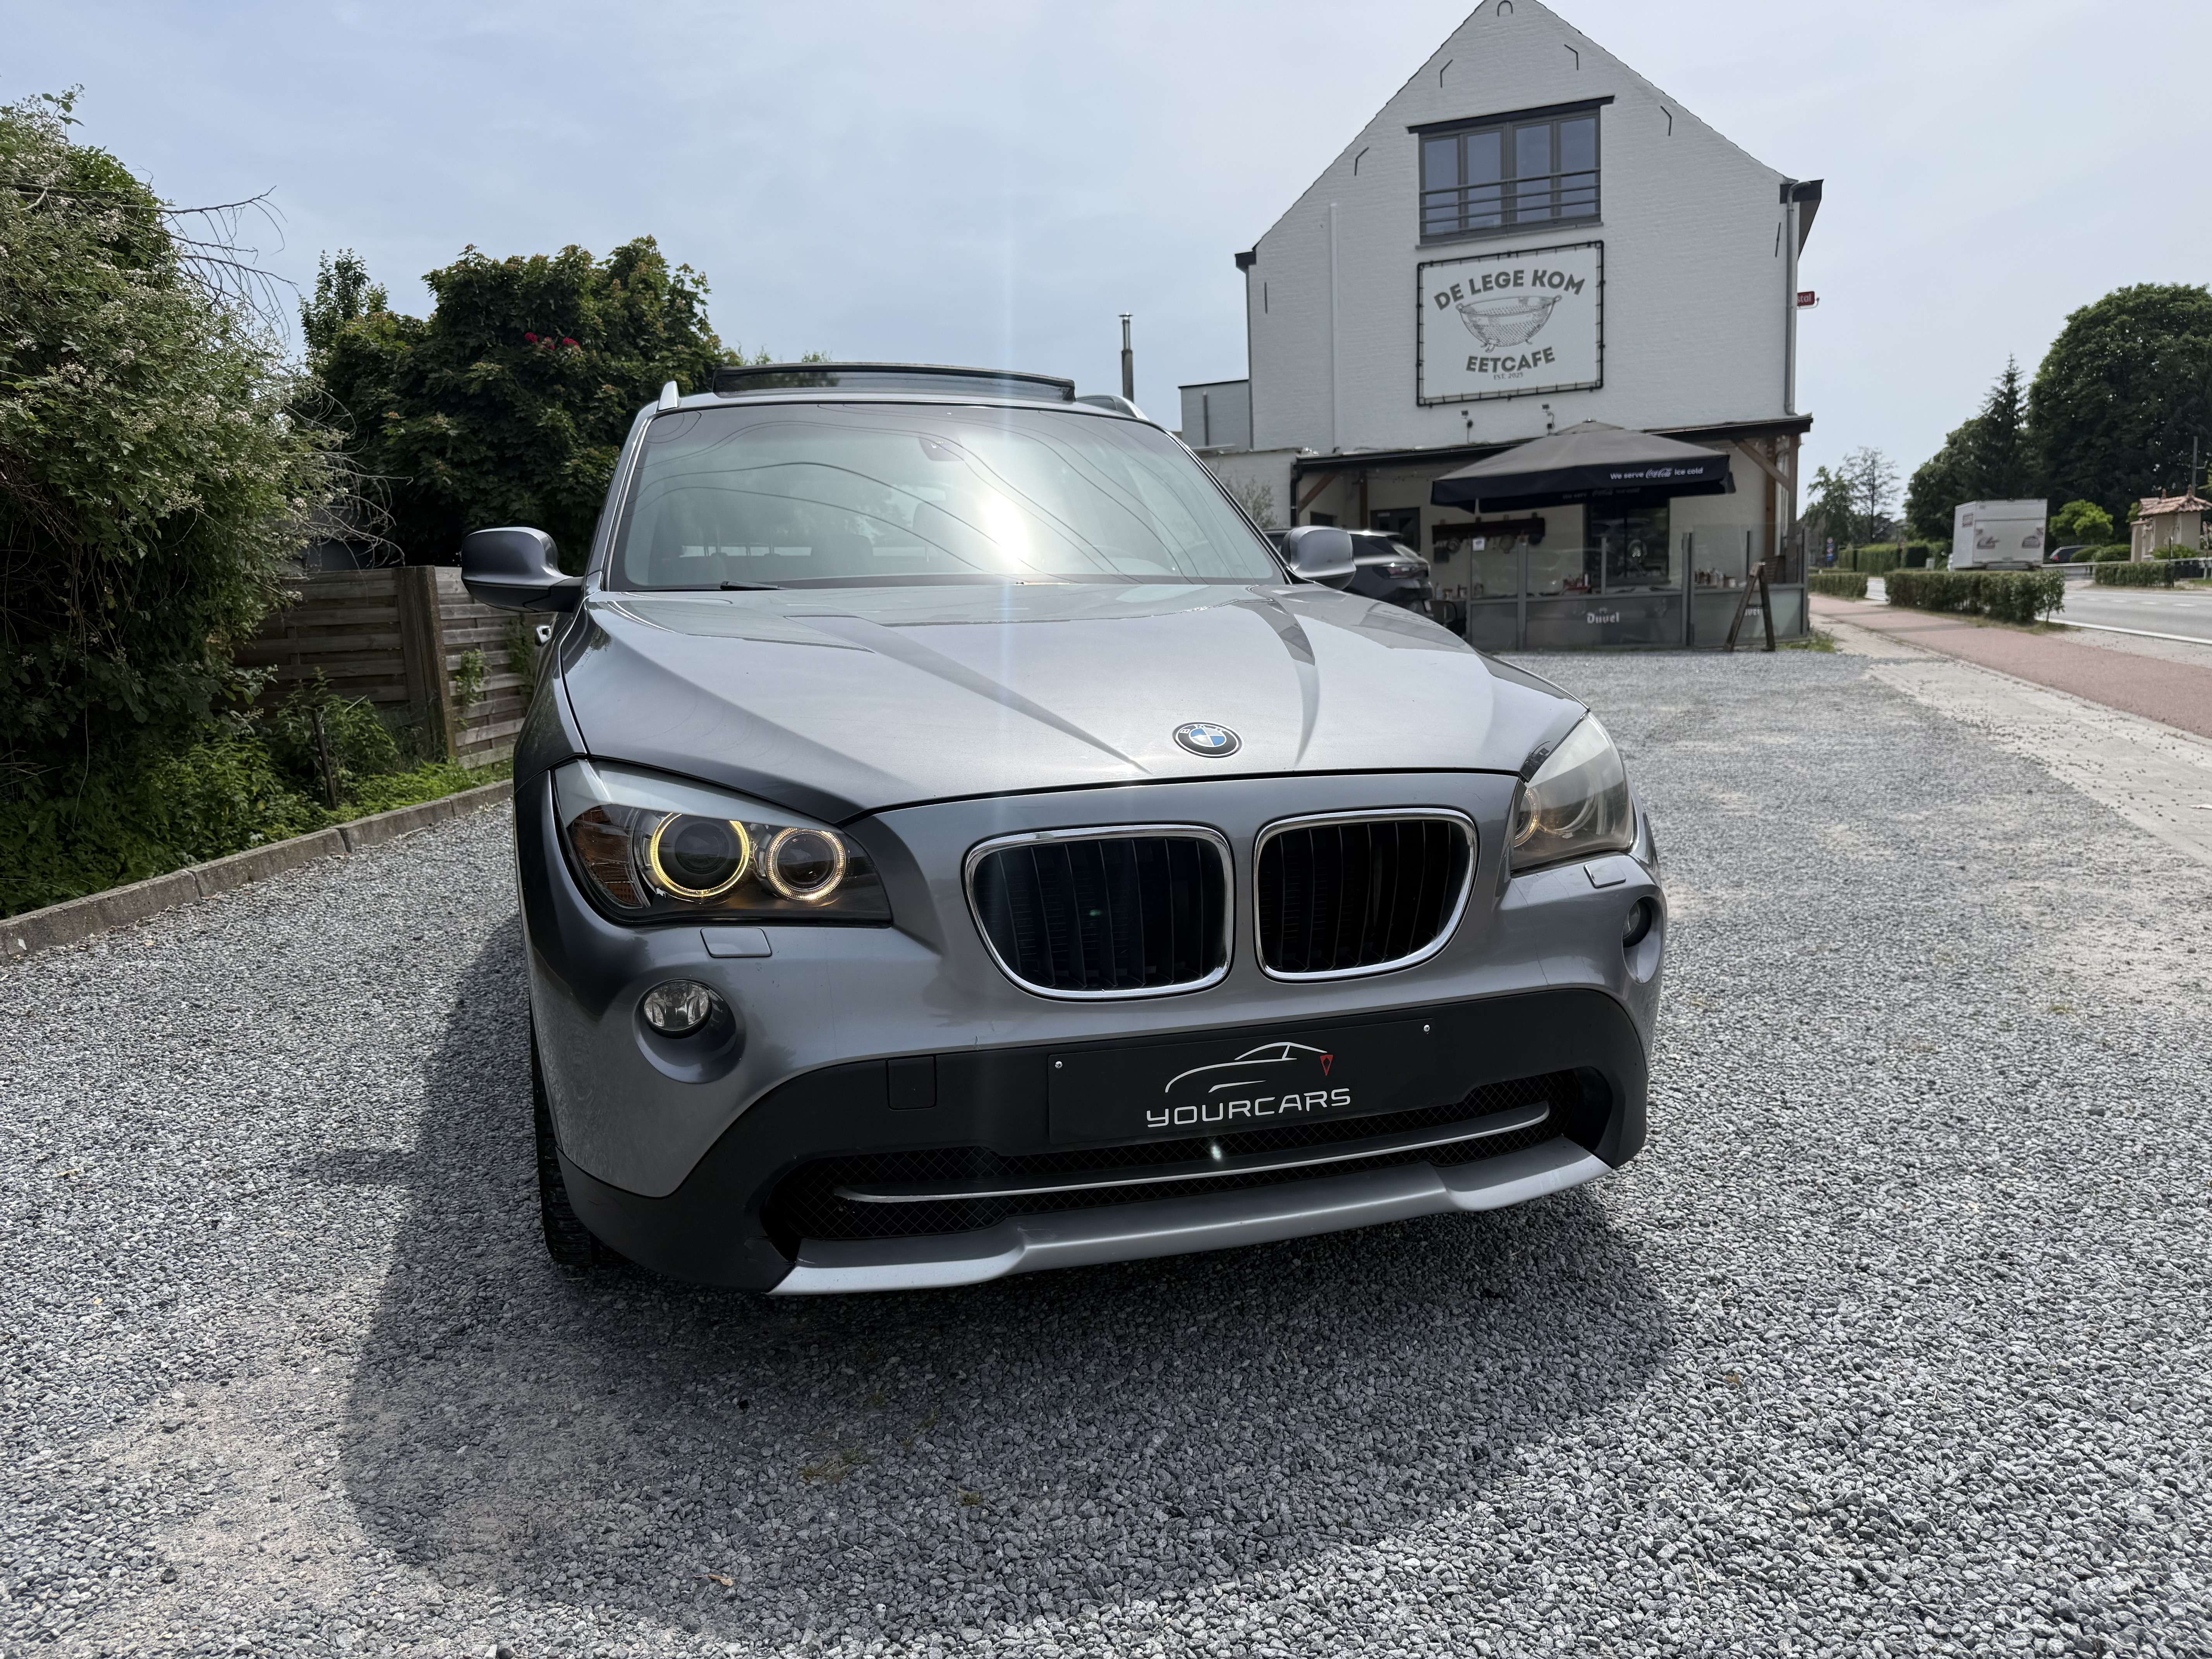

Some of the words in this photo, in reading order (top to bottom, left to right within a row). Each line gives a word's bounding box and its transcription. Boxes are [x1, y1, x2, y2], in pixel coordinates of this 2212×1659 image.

[1434, 283, 1464, 311] DE
[1469, 270, 1525, 295] LEGE
[1532, 270, 1585, 295] KOM
[1466, 347, 1556, 373] EETCAFE
[1687, 466, 1704, 475] cold
[1587, 611, 1620, 624] Duvel
[1179, 724, 1224, 734] BMW
[1146, 1088, 1351, 1128] YOURCARS
